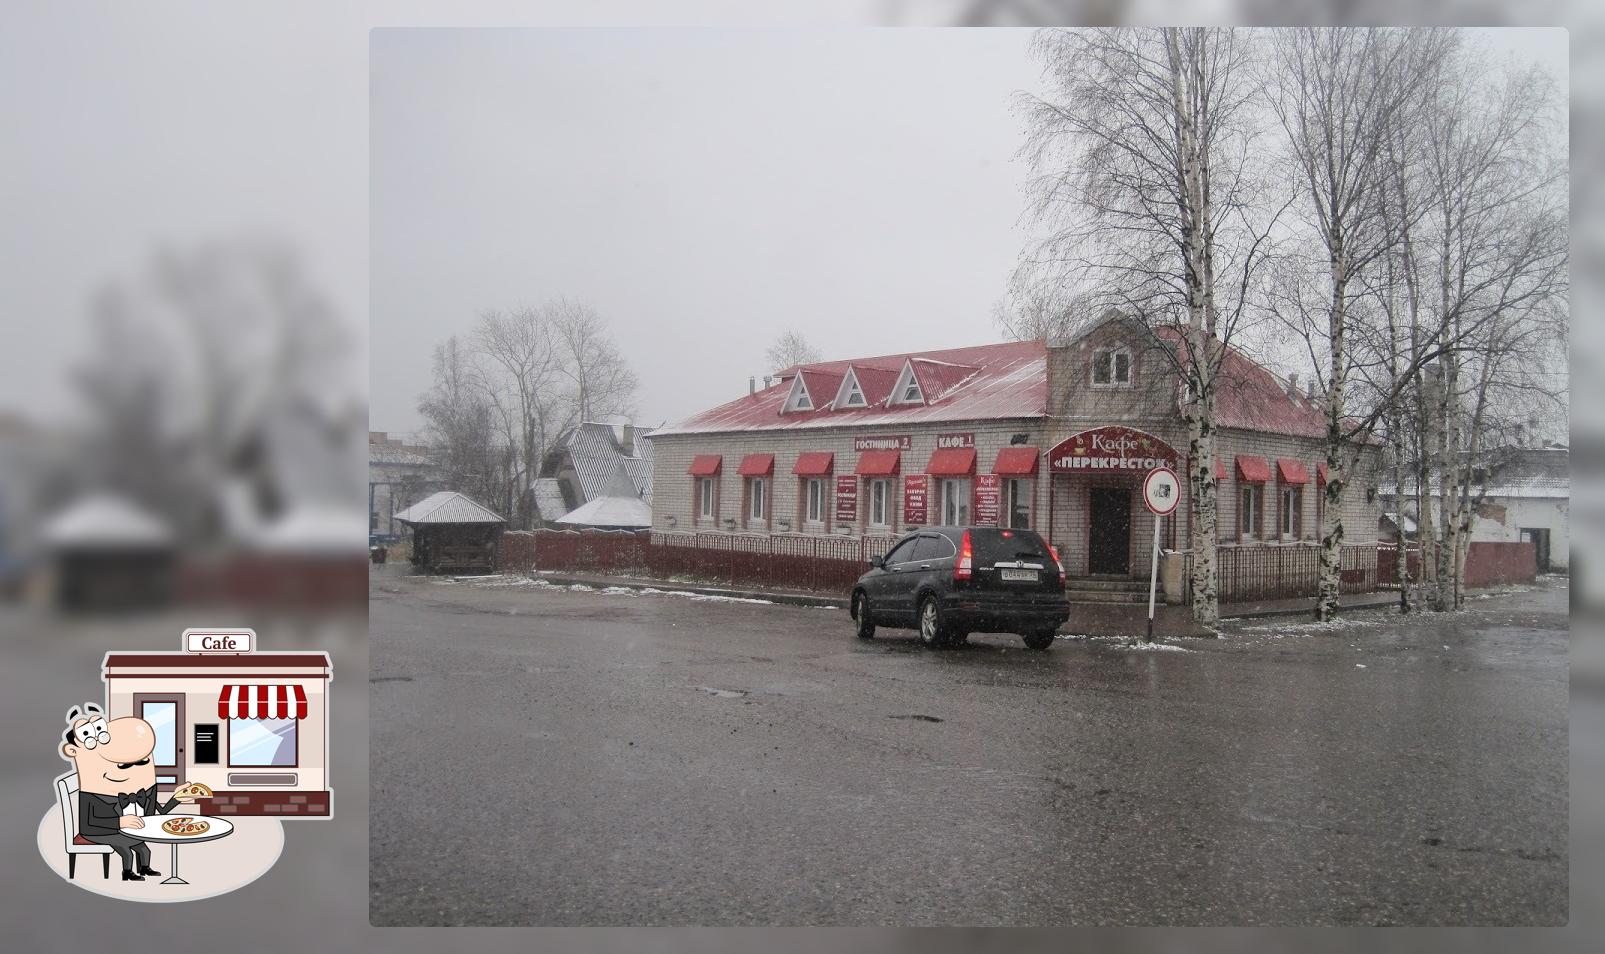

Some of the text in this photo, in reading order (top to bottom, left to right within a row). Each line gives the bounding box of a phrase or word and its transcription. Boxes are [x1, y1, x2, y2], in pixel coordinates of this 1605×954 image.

[855, 439, 900, 450] ГОСТИНИЦА
[938, 436, 965, 448] КАФЕ
[1091, 433, 1138, 457] Кафе
